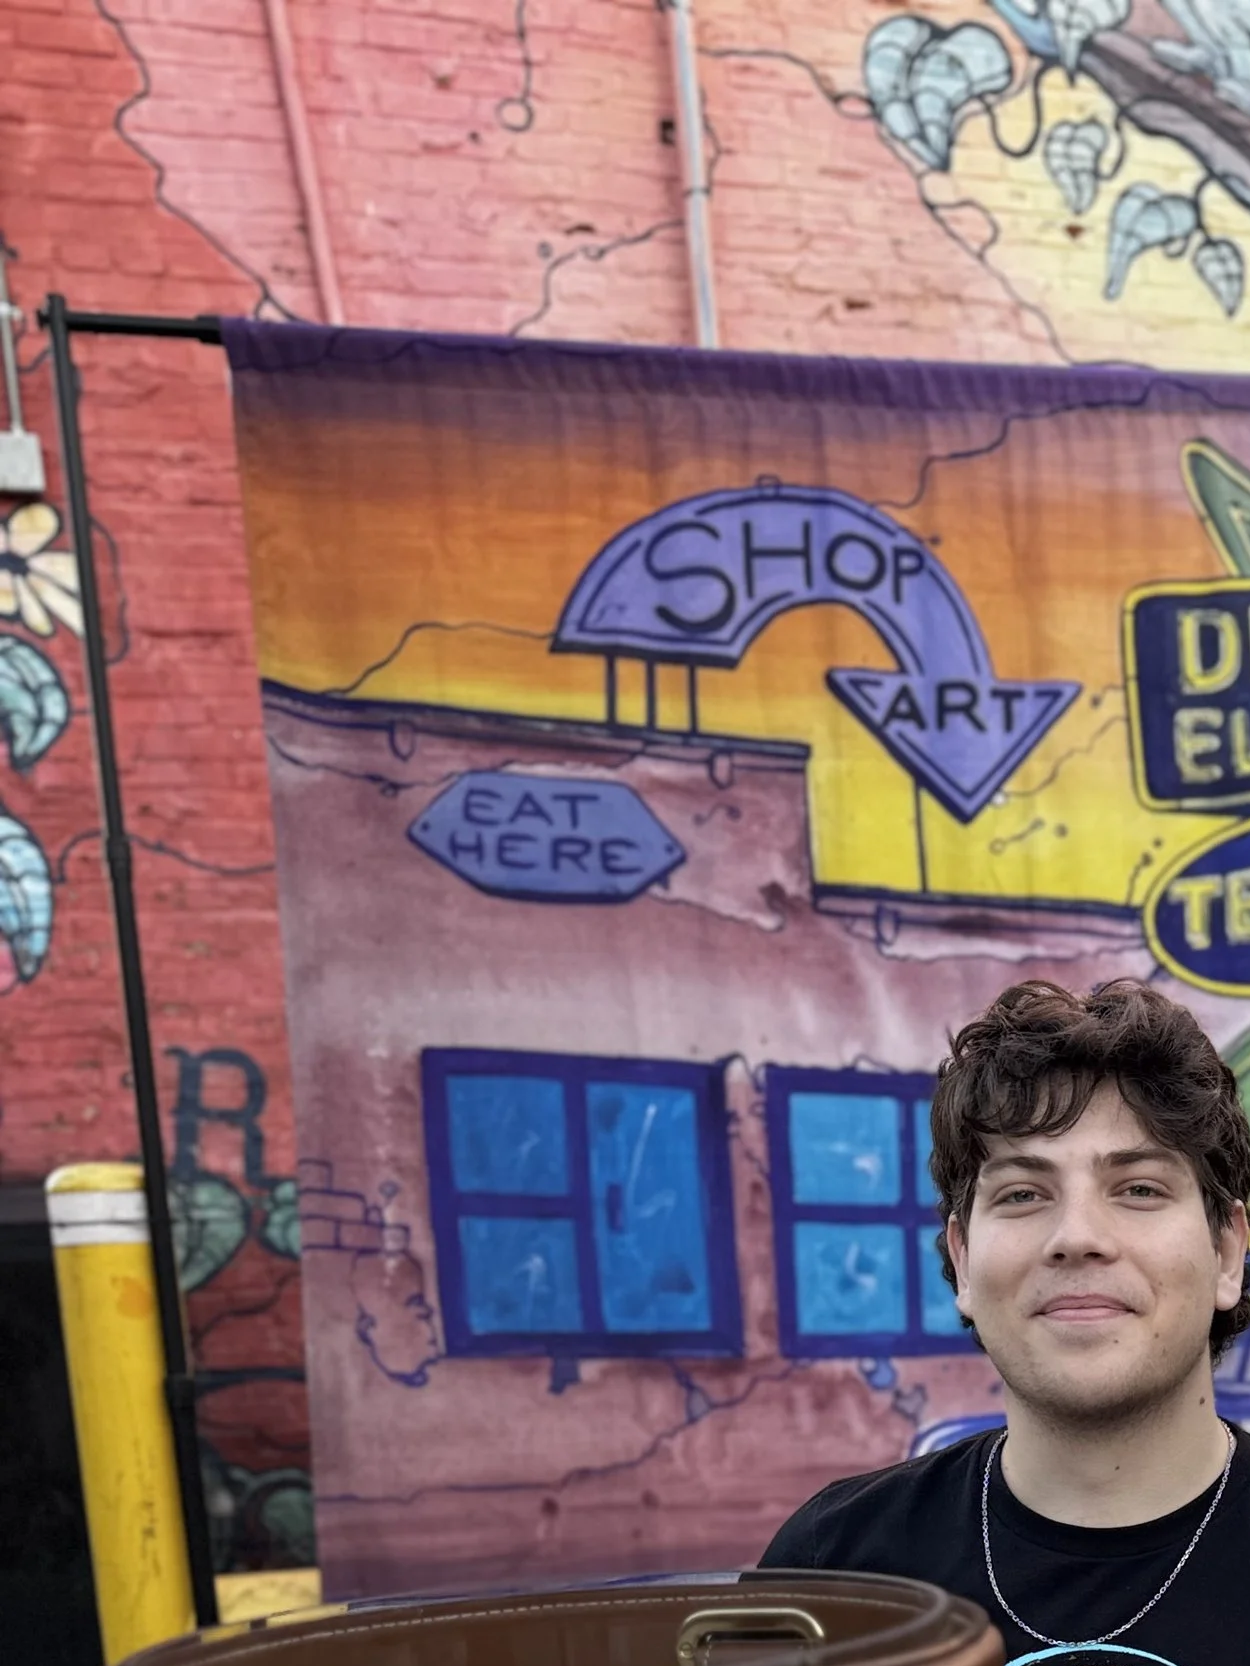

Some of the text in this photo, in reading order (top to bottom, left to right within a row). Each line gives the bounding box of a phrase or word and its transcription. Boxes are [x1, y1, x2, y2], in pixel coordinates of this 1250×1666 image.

[645, 520, 927, 633] SHOP
[880, 680, 1026, 735] ART
[463, 788, 600, 830] EAT
[449, 831, 644, 875] HERE
